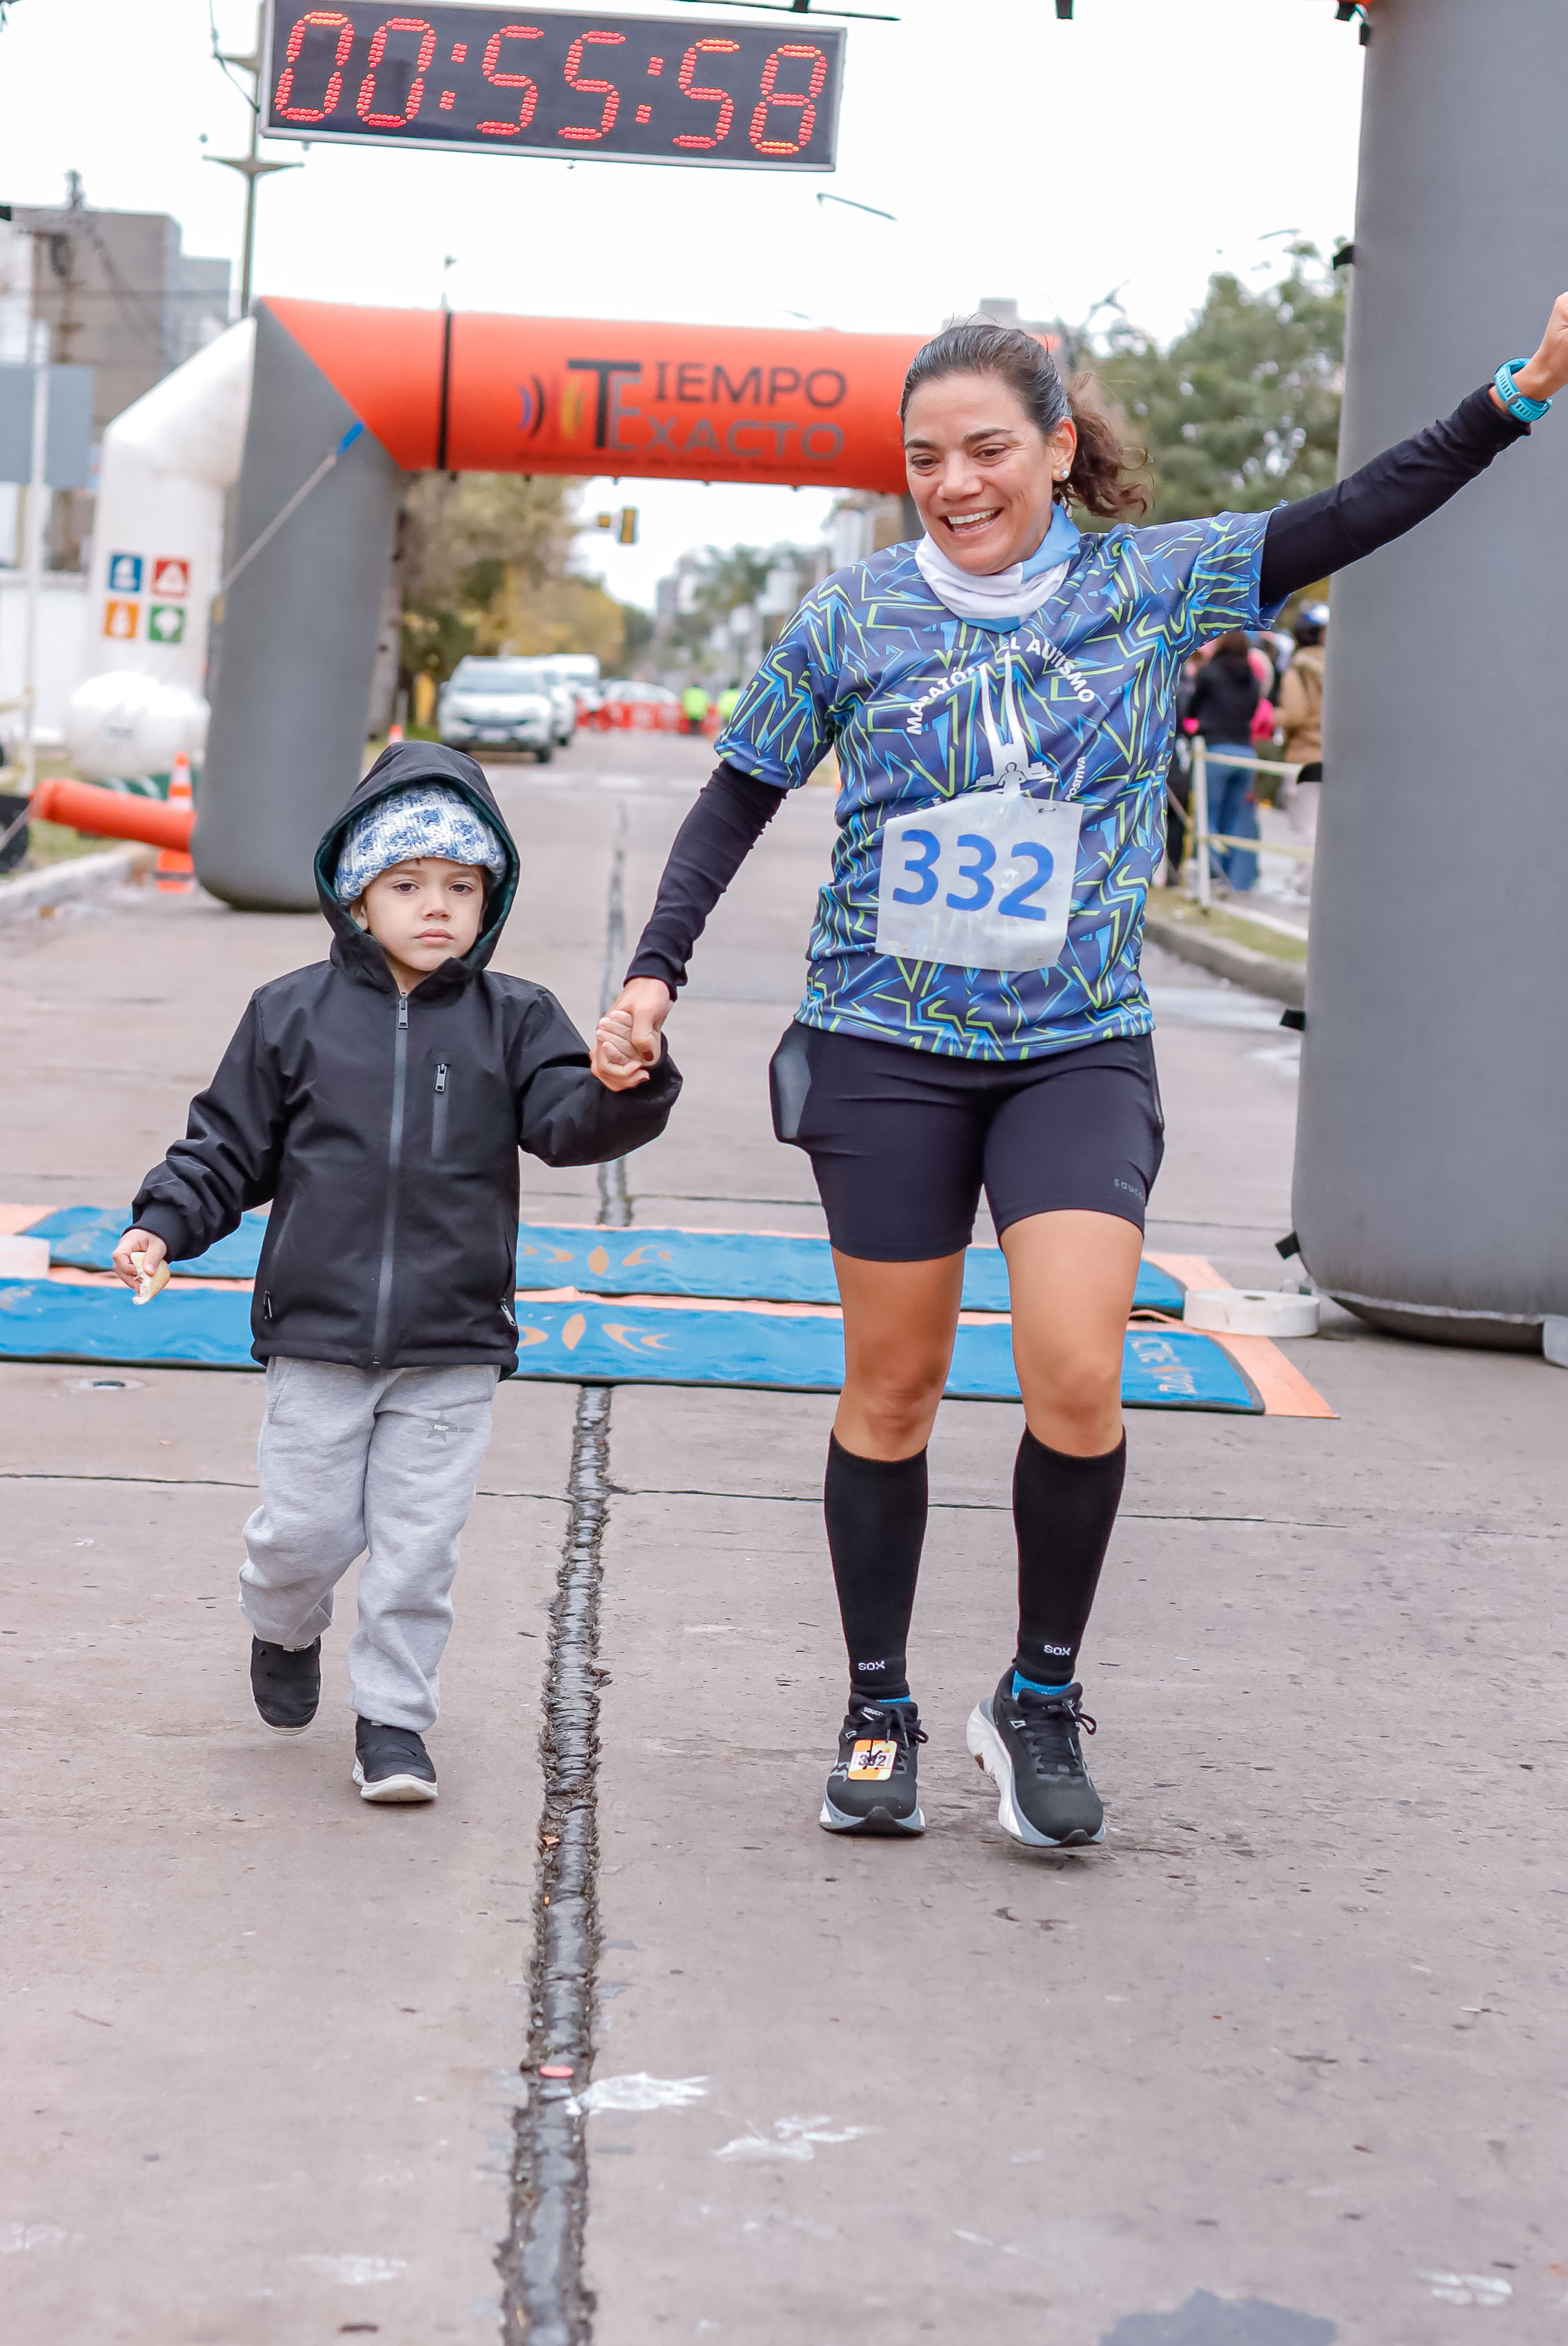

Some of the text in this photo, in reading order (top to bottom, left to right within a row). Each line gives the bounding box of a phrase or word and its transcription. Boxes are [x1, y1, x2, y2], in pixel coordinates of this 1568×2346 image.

[275, 10, 827, 156] 00:55:58
[566, 358, 847, 448] TIEMPO
[608, 372, 844, 461] EXACTO
[1026, 639, 1095, 702] AUTISMO
[893, 828, 1054, 921] 332
[857, 1660, 885, 1670] SOX
[1043, 1644, 1071, 1656] SOX
